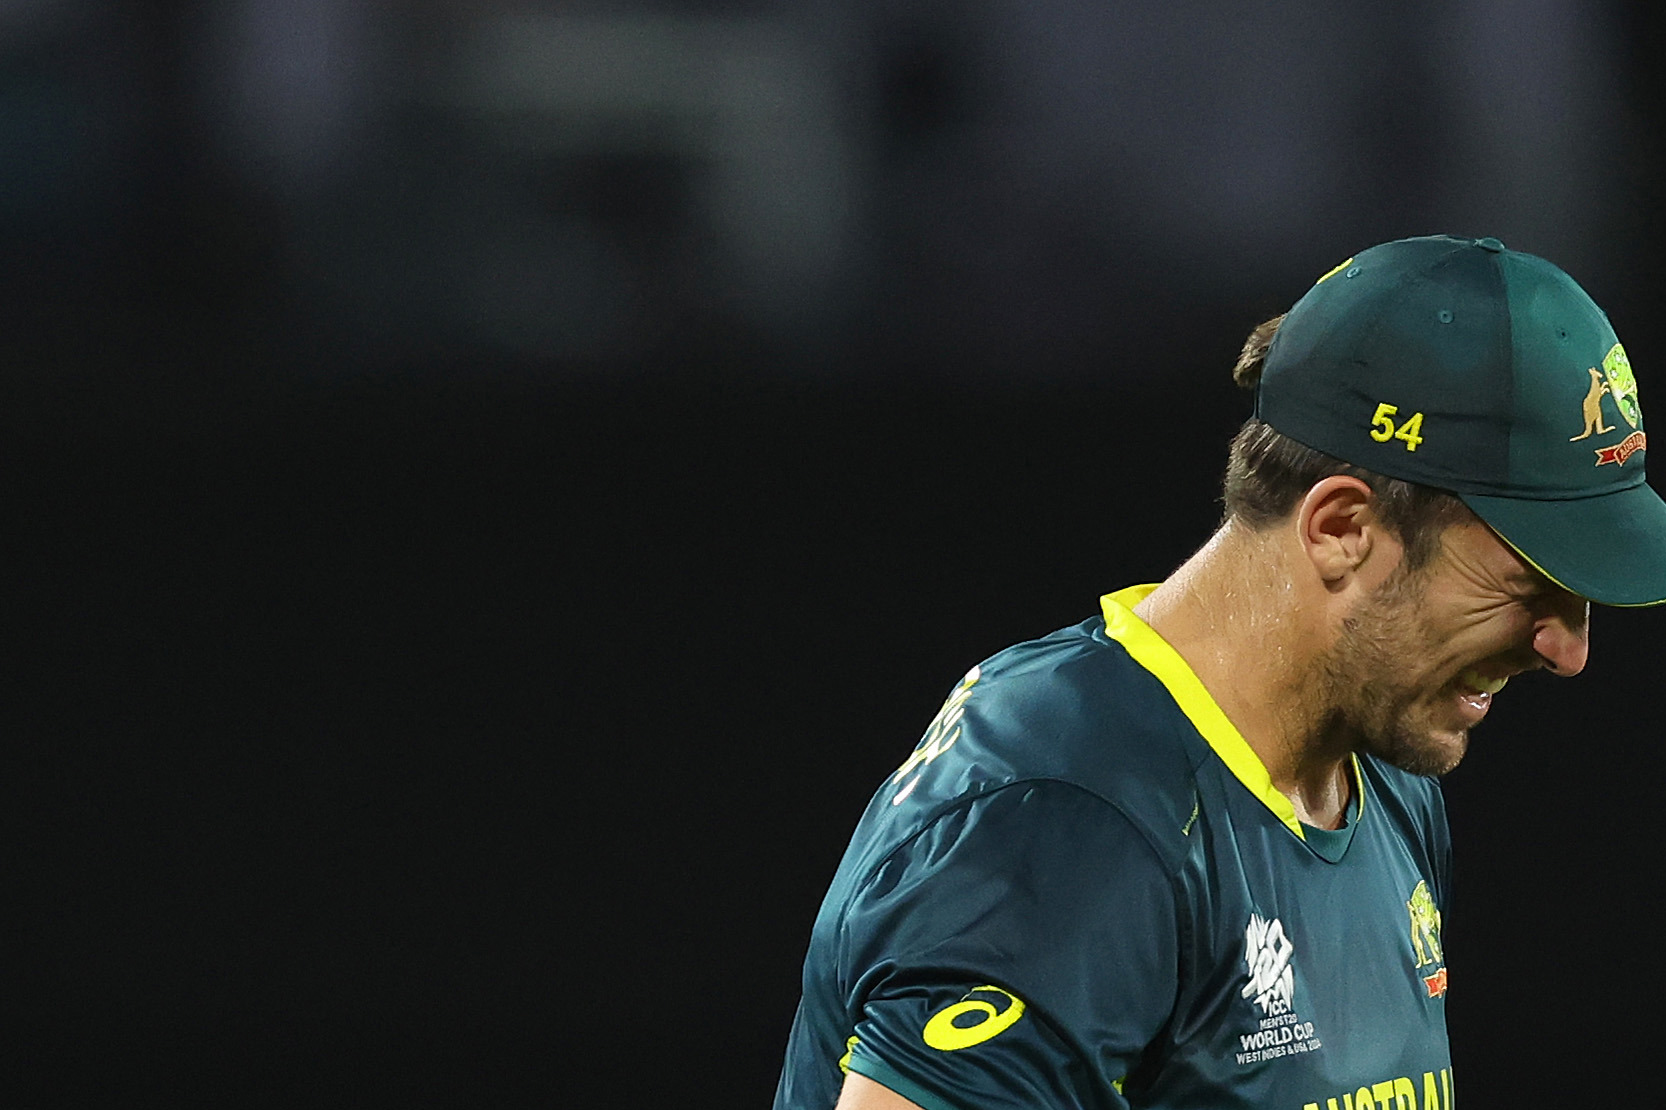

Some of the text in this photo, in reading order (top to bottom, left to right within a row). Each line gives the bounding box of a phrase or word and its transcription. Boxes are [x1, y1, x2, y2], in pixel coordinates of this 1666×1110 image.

[1370, 403, 1424, 452] 54
[1268, 1000, 1287, 1017] ICC
[1240, 1021, 1314, 1051] WORLD CUP
[1236, 1051, 1261, 1065] WEST
[1262, 1046, 1286, 1061] INDIES
[1287, 1044, 1295, 1055] &
